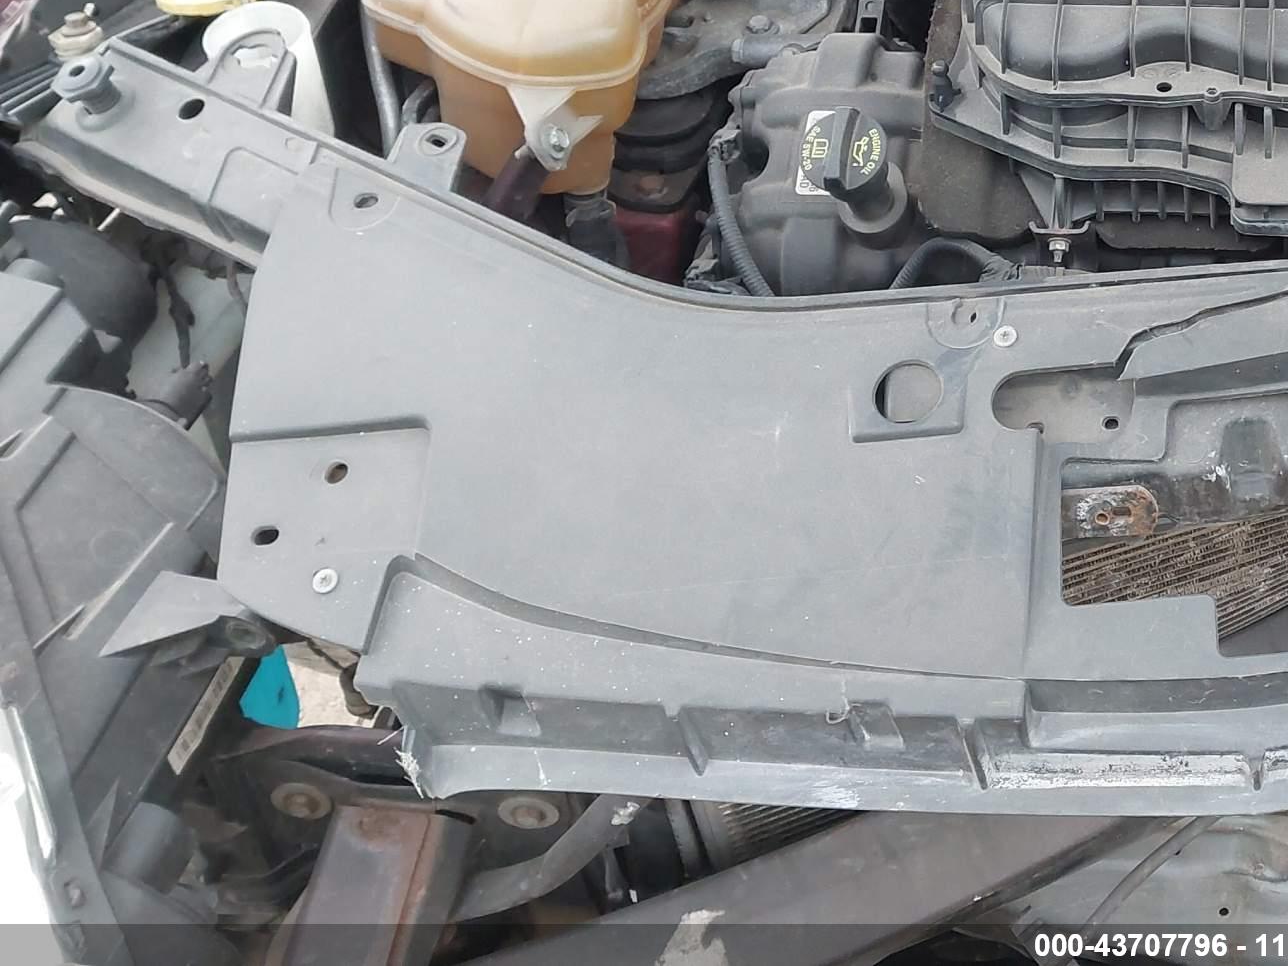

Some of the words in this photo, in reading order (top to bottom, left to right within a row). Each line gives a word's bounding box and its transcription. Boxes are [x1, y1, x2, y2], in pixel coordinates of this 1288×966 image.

[806, 126, 821, 142] SAE
[869, 129, 881, 160] ENGINE
[802, 144, 812, 170] 5W-20
[860, 162, 875, 175] OIL
